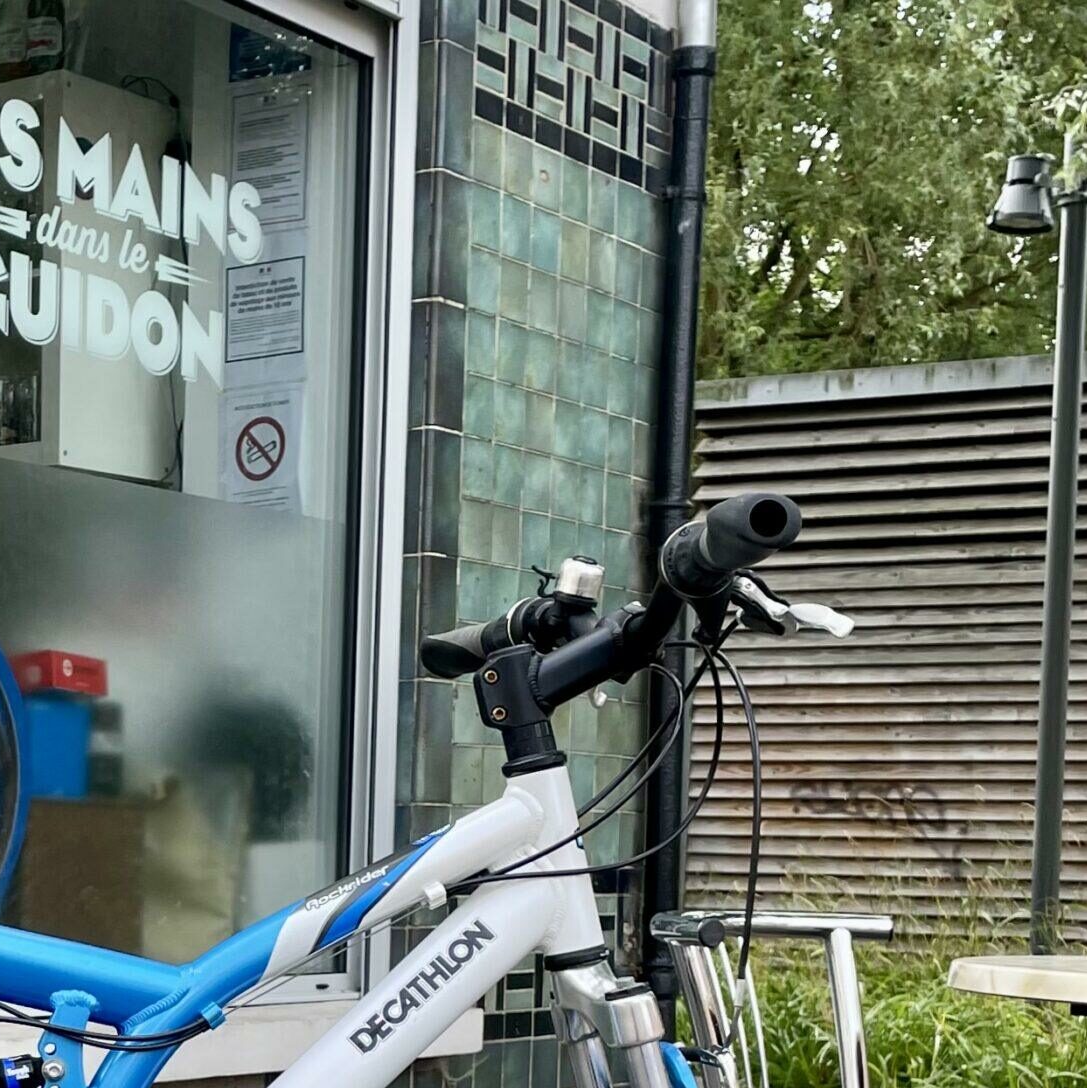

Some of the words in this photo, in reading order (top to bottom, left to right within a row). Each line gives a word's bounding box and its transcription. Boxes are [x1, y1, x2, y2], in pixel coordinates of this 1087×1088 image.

[36, 205, 110, 263] dans
[119, 229, 149, 273] le
[57, 115, 264, 264] MAINS
[305, 864, 390, 911] Rockrider
[349, 919, 496, 1054] DECATHLON
